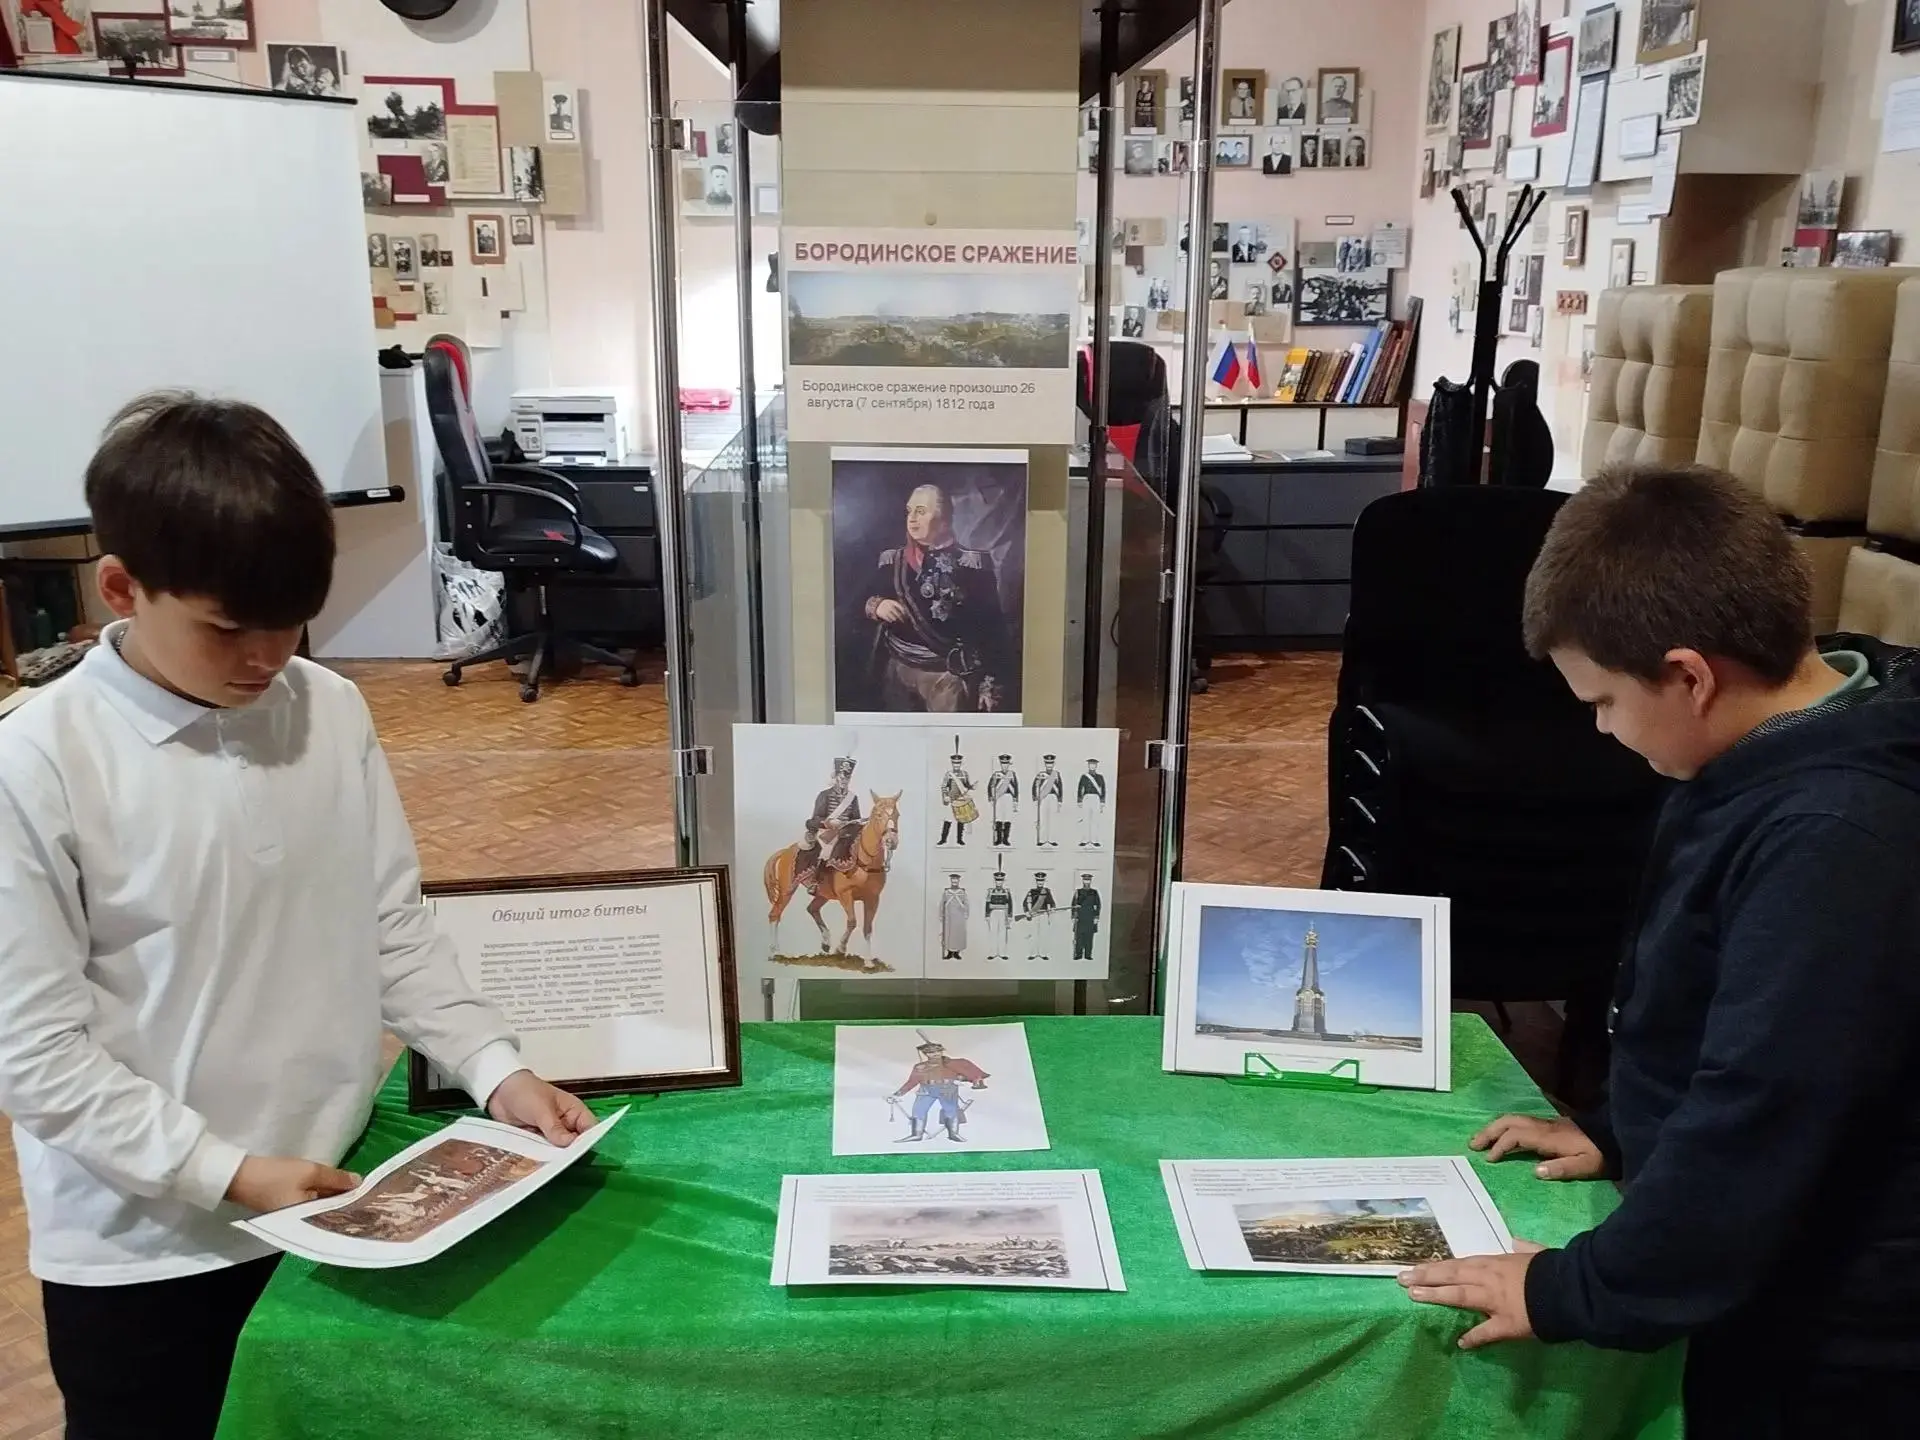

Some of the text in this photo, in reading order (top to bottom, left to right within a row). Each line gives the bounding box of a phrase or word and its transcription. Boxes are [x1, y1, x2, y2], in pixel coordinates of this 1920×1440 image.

[795, 243, 1078, 265] БОРОДИНСКОЕ СРАЖЕНИЕ
[802, 380, 1036, 395] Бородинское сражение произошло 26
[807, 397, 995, 412] августа (7 сентября) 1812 года
[492, 904, 648, 924] Общий итог битвы
